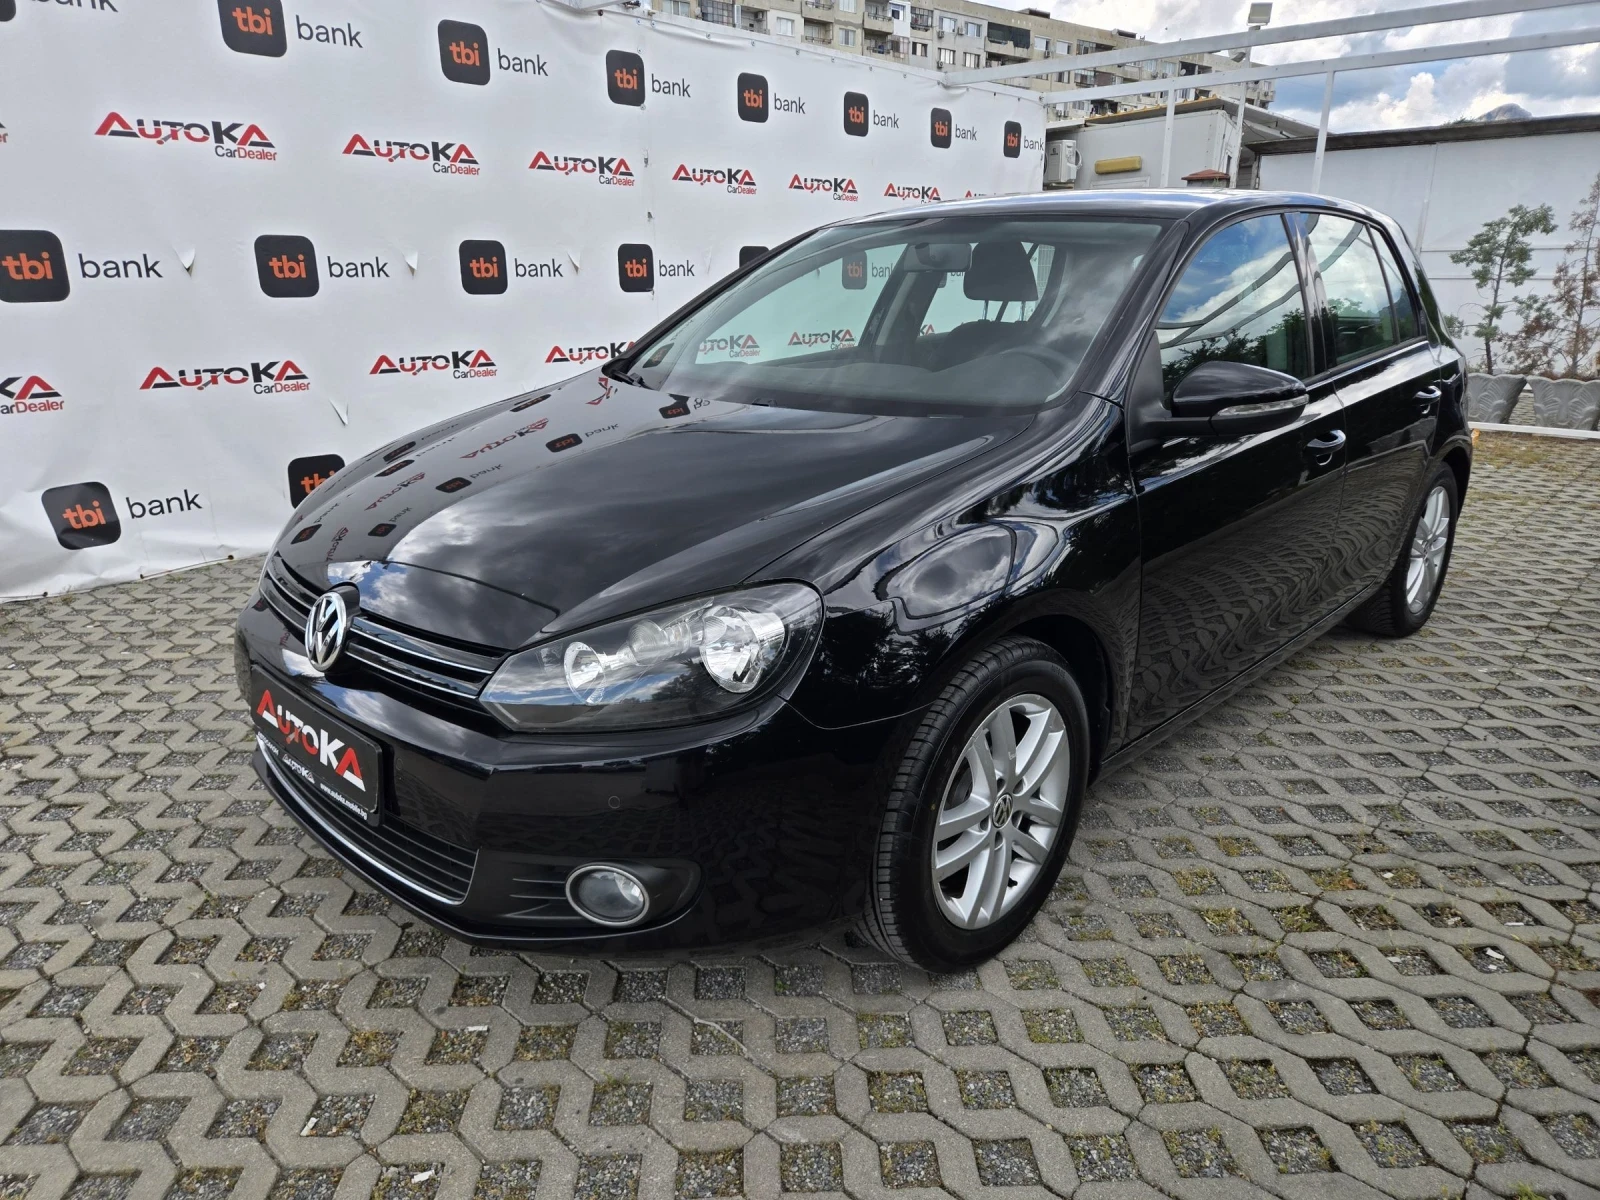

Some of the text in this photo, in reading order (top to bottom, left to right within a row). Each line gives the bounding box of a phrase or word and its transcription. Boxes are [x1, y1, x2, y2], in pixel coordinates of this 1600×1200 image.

[232, 7, 363, 48] tbi bank
[449, 41, 548, 76] tbi bank
[614, 69, 691, 98] tbi bank
[743, 89, 806, 115] tbi bank
[848, 106, 900, 129] tbi bank
[935, 120, 978, 141] tbi bank
[1007, 133, 1044, 152] tbi bank
[2, 252, 163, 280] tbi bank
[269, 254, 390, 279] tbi bank
[470, 257, 563, 278] tbi bank
[625, 258, 695, 278] tbi bank
[847, 262, 863, 278] tbi
[0, 399, 65, 415] arDealer
[63, 489, 203, 530] tbi bank
